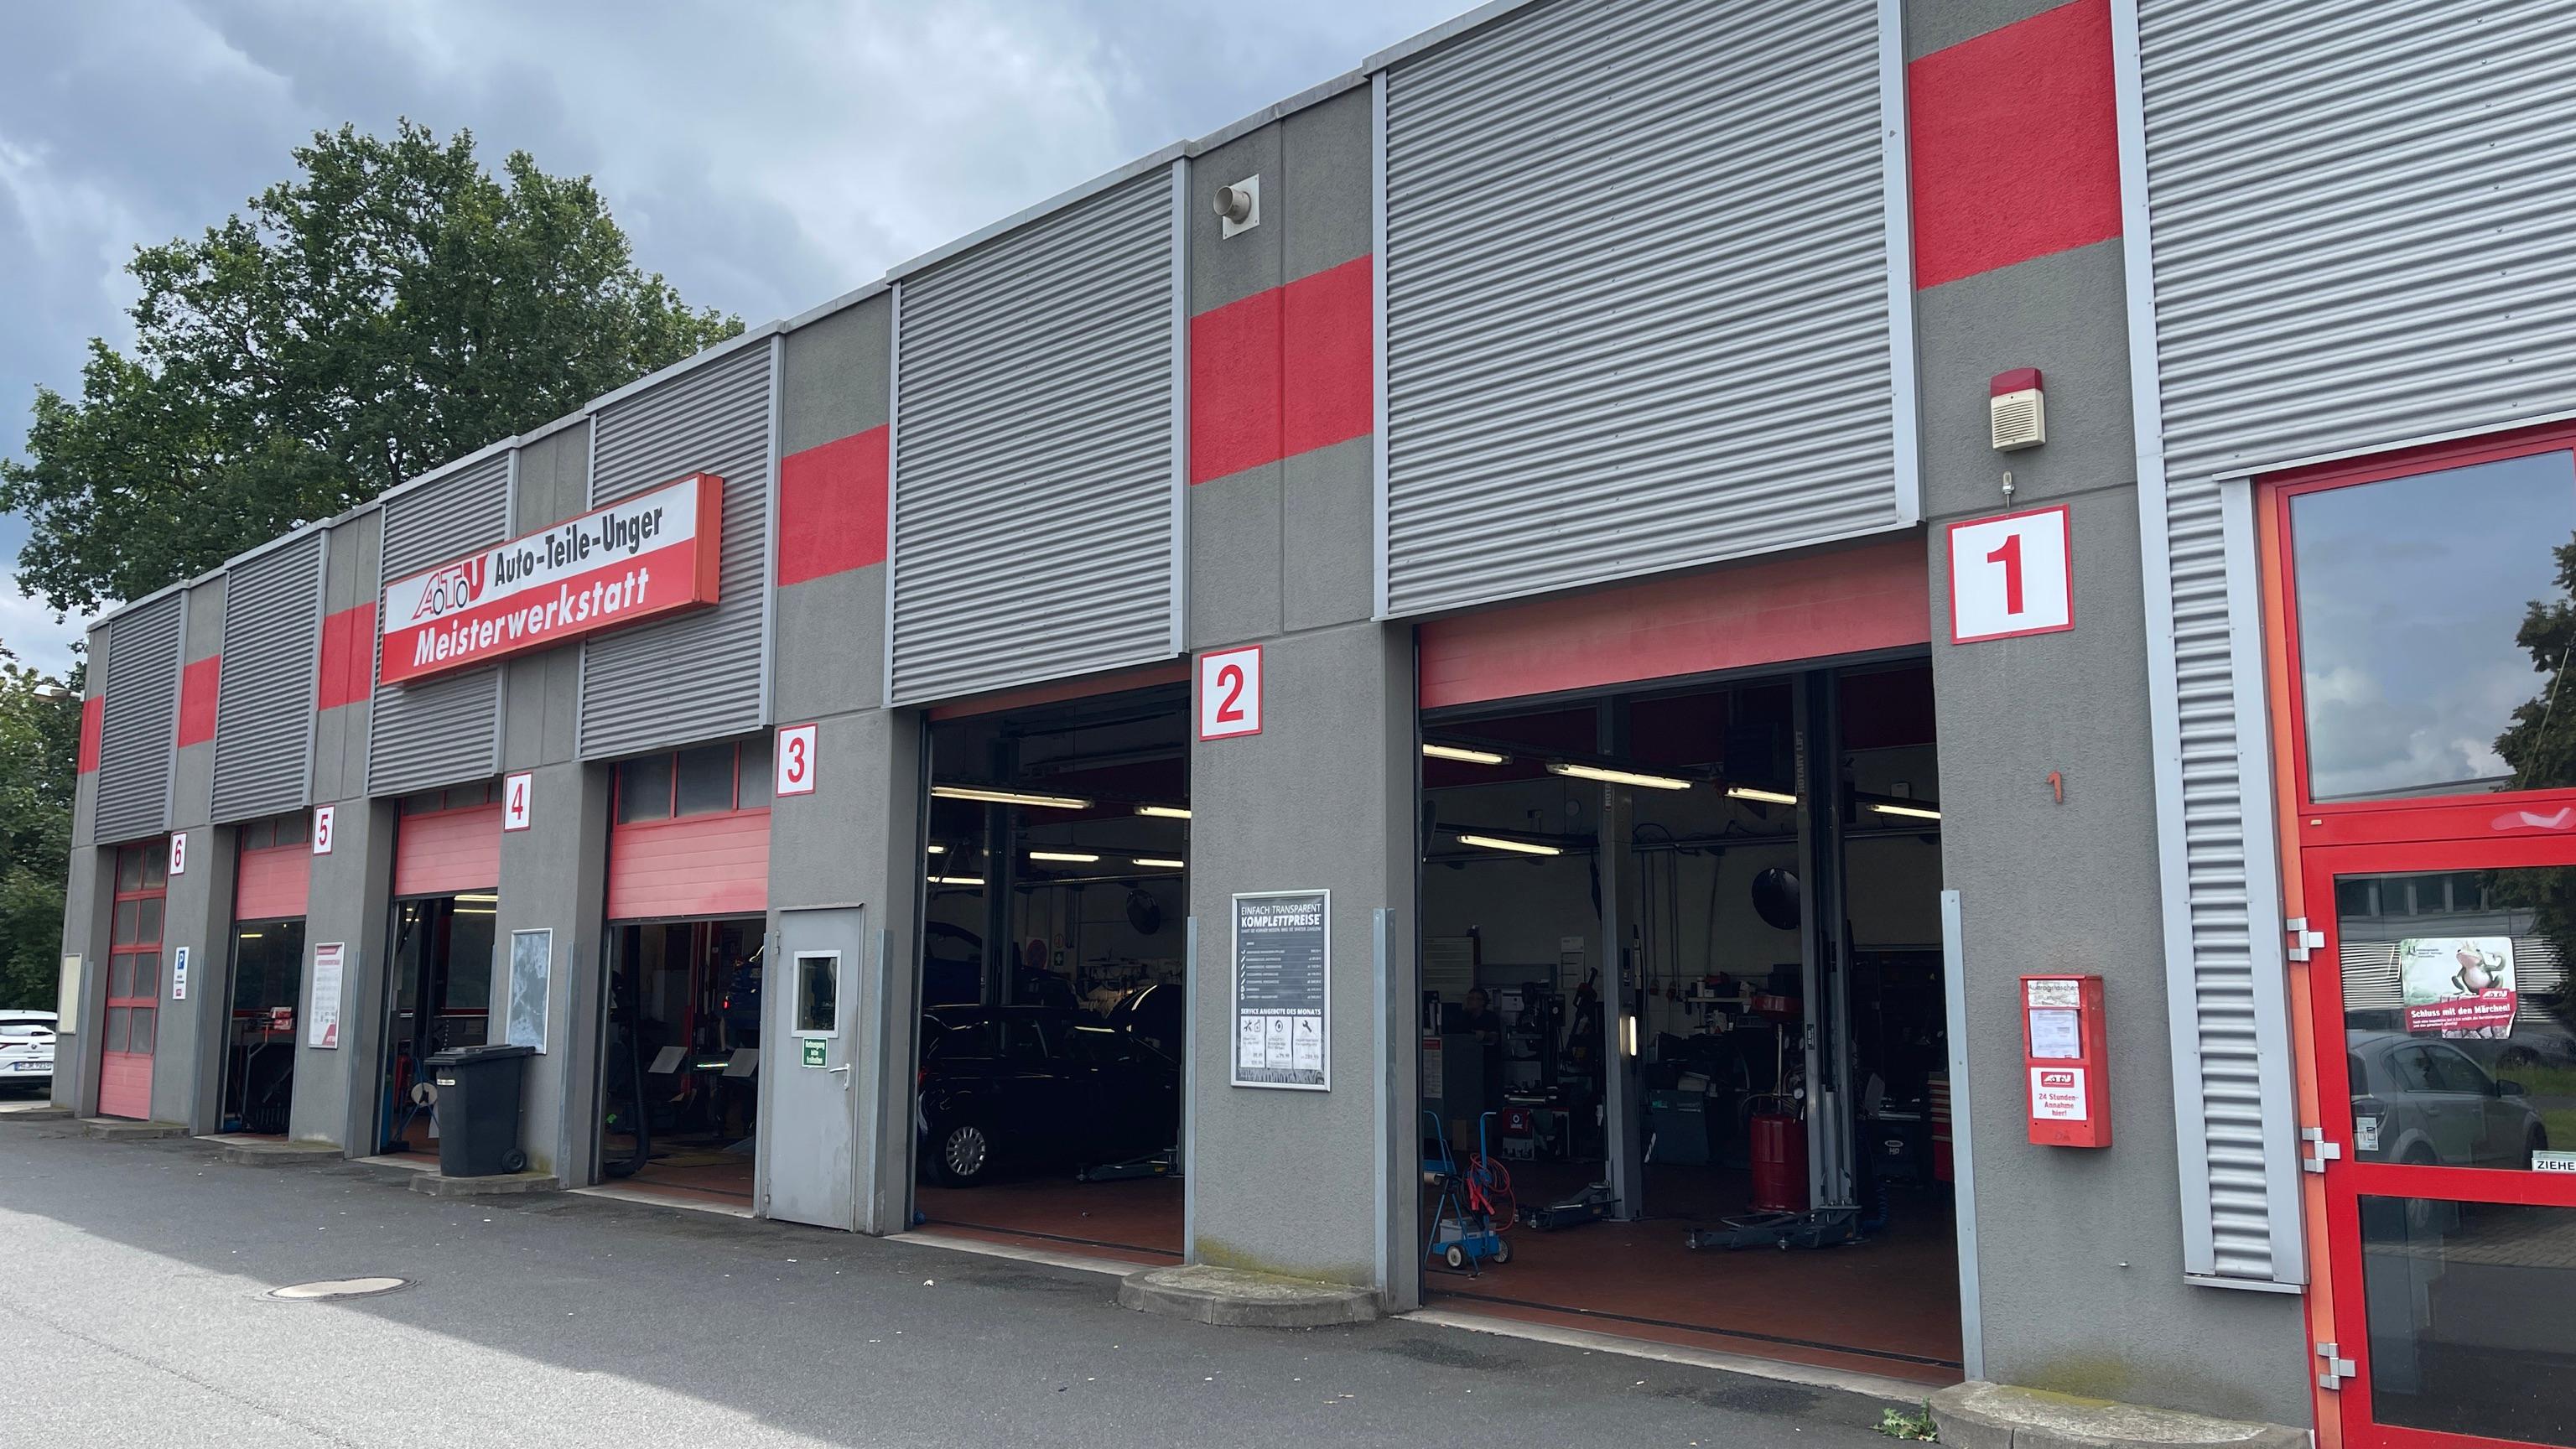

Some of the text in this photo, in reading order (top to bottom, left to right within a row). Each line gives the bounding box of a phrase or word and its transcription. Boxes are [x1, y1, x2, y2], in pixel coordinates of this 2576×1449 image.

[495, 506, 662, 587] Auto-Teile-Unger
[1987, 534, 2024, 615] 1
[413, 567, 649, 667] Meisterwerkstatt
[1216, 664, 1244, 723] 2
[787, 737, 805, 783] 3
[511, 783, 523, 820] 4
[319, 813, 329, 845] 5
[174, 839, 182, 867] 6
[1241, 903, 1322, 916] EINFACH TRANSPARENT
[2411, 1009, 2440, 1018] Schluss
[2442, 1007, 2455, 1015] mit
[2458, 1006, 2473, 1015] den
[2049, 1093, 2079, 1101] Stunden-
[2537, 1161, 2575, 1171] ZIEHE
